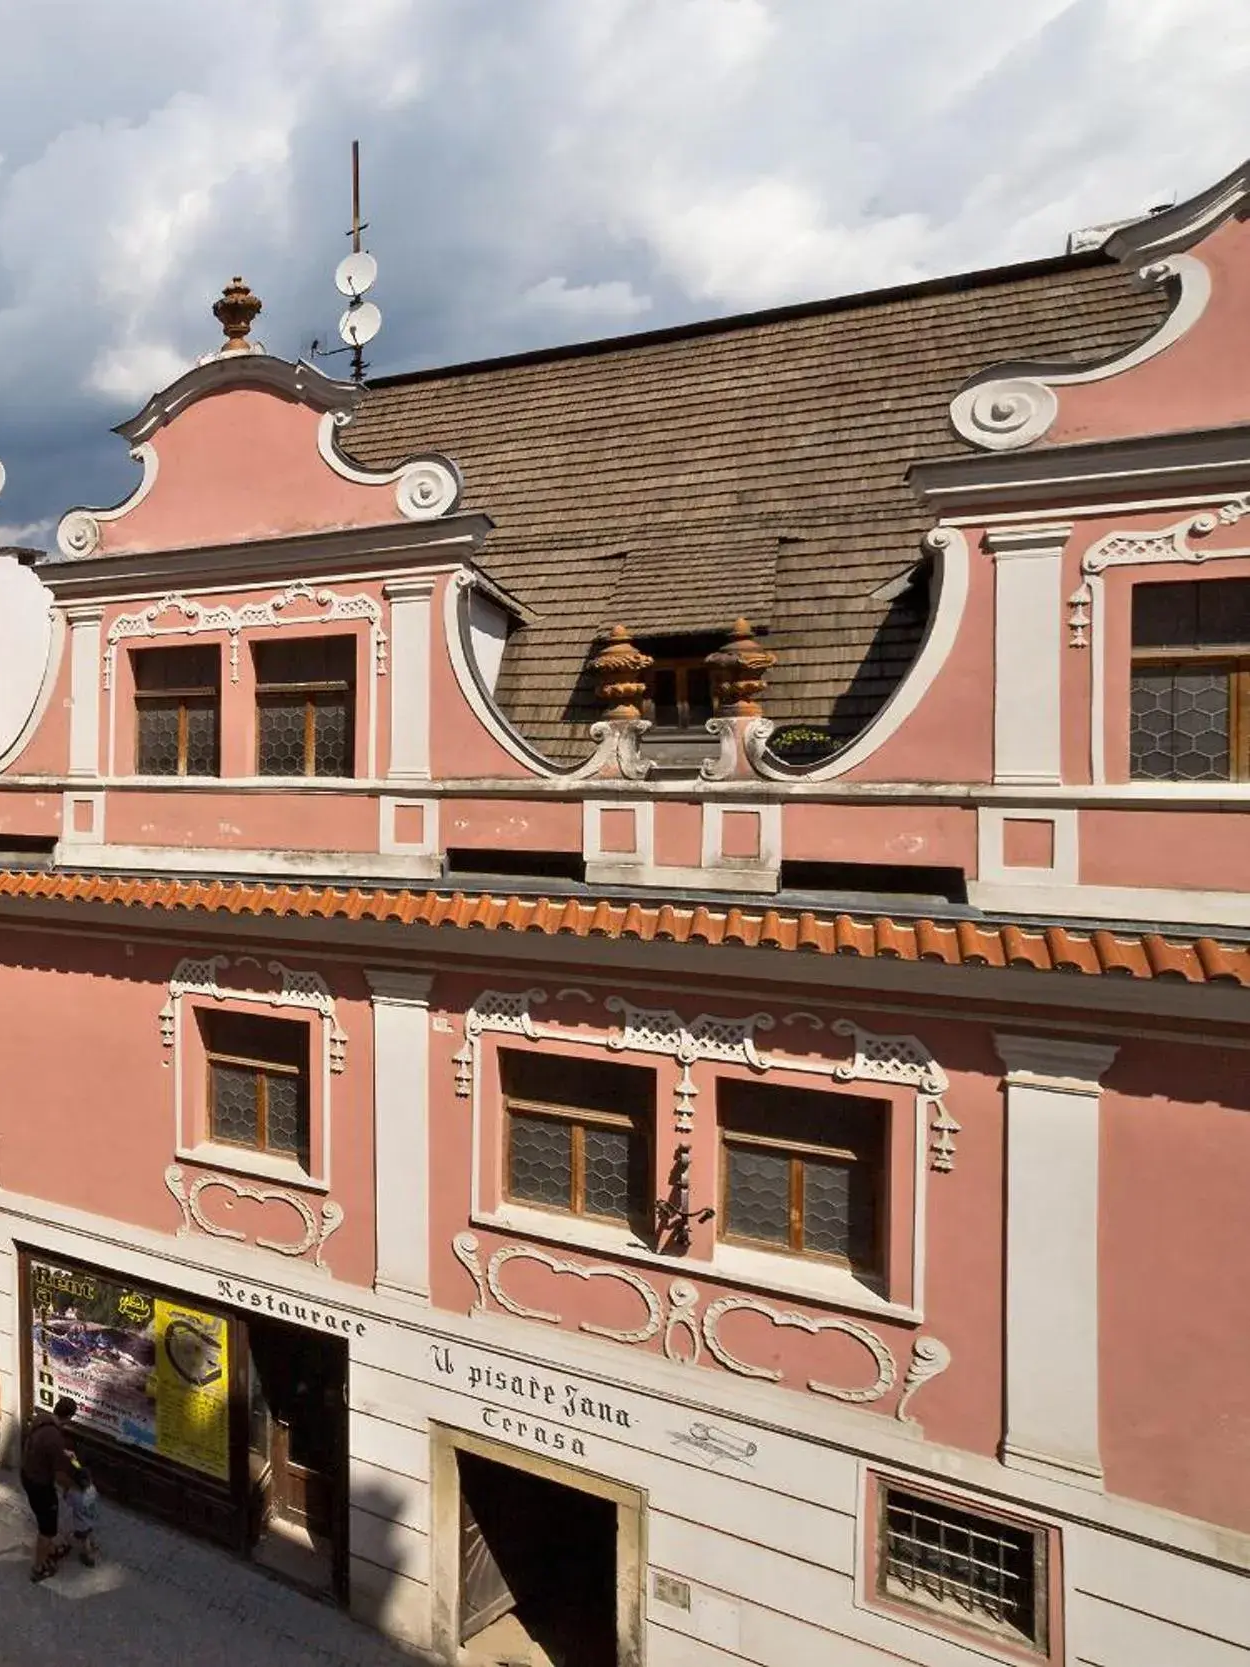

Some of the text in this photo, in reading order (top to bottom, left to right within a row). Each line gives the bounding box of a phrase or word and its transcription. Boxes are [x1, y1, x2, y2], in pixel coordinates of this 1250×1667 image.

[217, 1280, 367, 1337] Restaurace
[562, 1385, 631, 1428] Jana
[482, 1407, 585, 1456] Terasa
